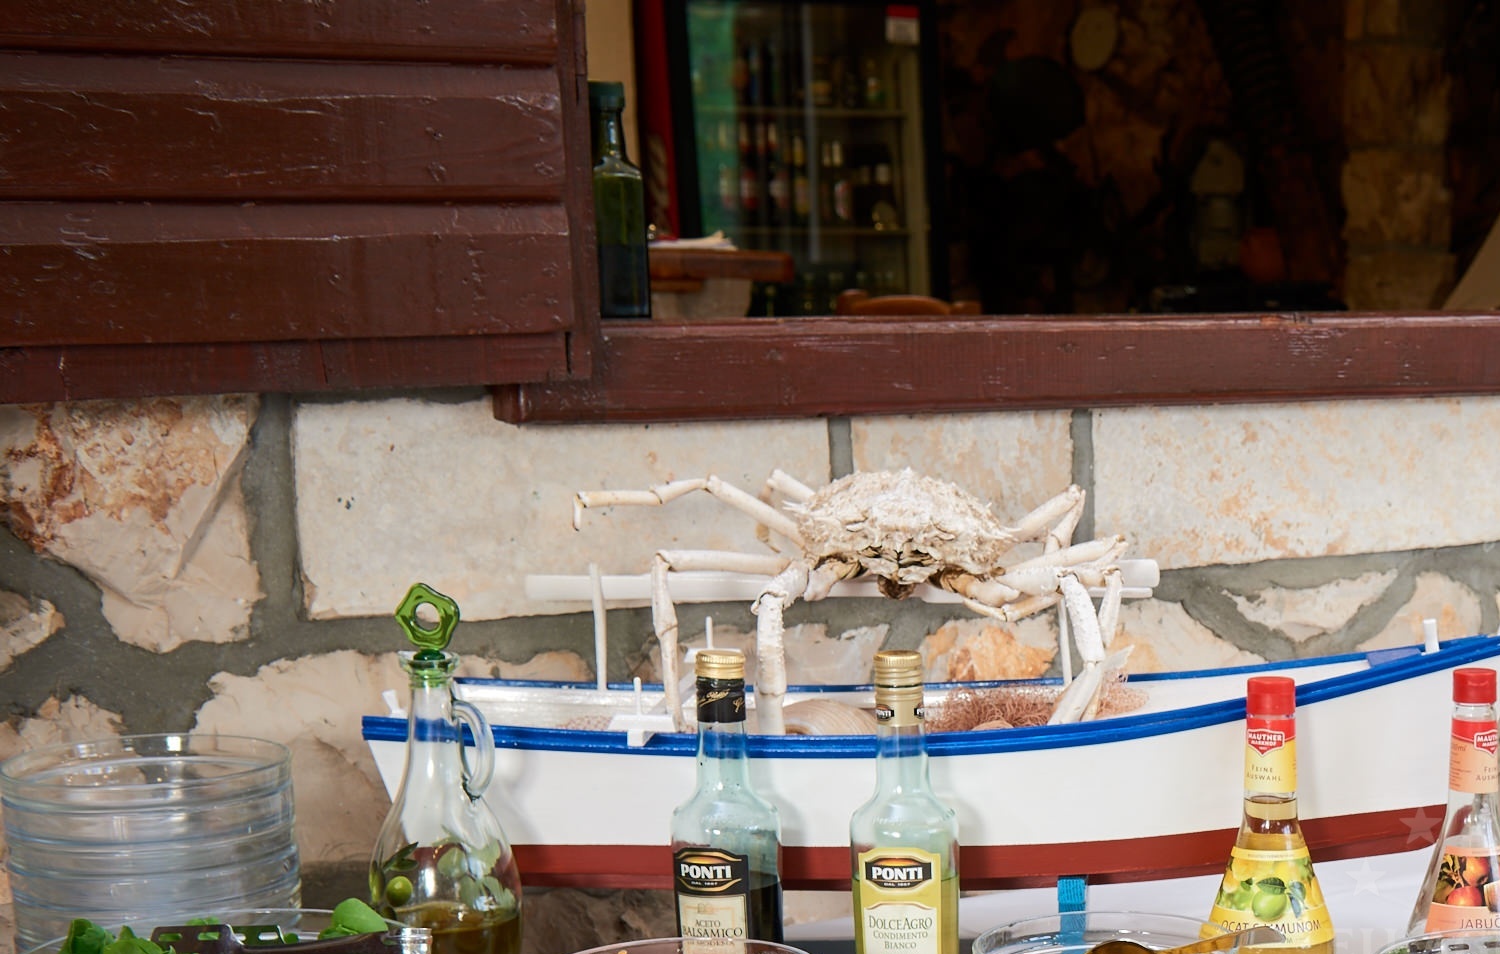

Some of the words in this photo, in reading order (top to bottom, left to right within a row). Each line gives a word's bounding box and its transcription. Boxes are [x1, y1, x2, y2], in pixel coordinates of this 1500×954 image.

[1248, 732, 1282, 741] MAUTNER
[1251, 764, 1273, 773] FEINE
[1247, 771, 1281, 782] AUSWAHL
[680, 863, 732, 879] PONTI
[871, 866, 923, 880] PONTI
[695, 919, 721, 928] ACETO
[1221, 920, 1249, 932] OCAT
[683, 925, 743, 938] BALSAMICO
[873, 930, 929, 939] CONDIMENTO
[884, 941, 917, 949] BIANCO
